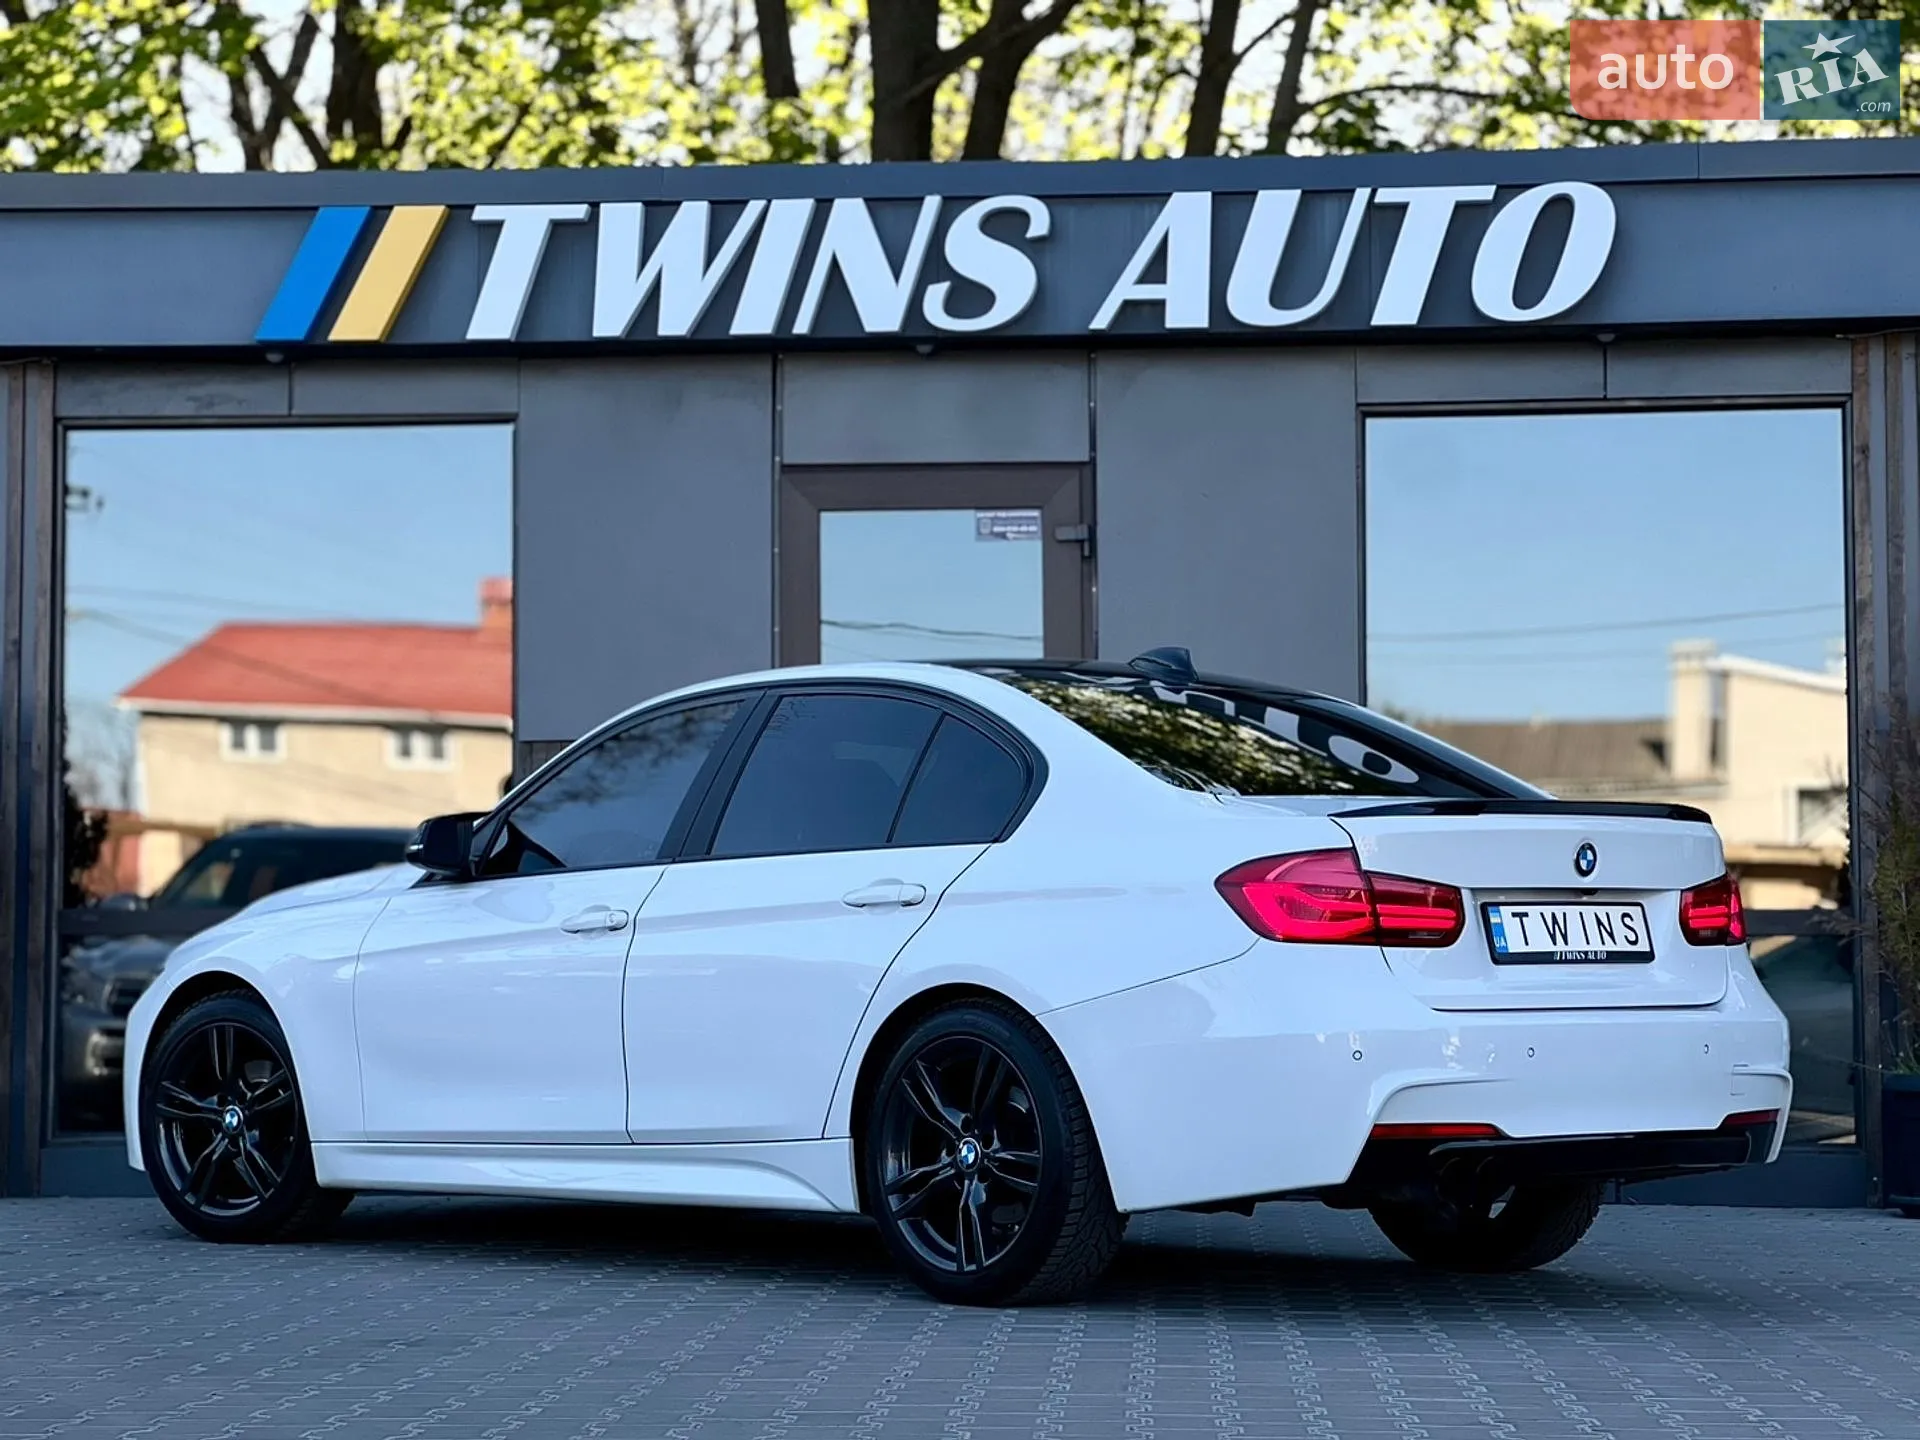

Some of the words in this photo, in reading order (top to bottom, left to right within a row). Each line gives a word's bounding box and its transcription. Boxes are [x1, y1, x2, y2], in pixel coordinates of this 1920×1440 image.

[465, 194, 1051, 341] TWINS
[1088, 181, 1617, 330] AUTO
[1510, 911, 1639, 946] TWINS
